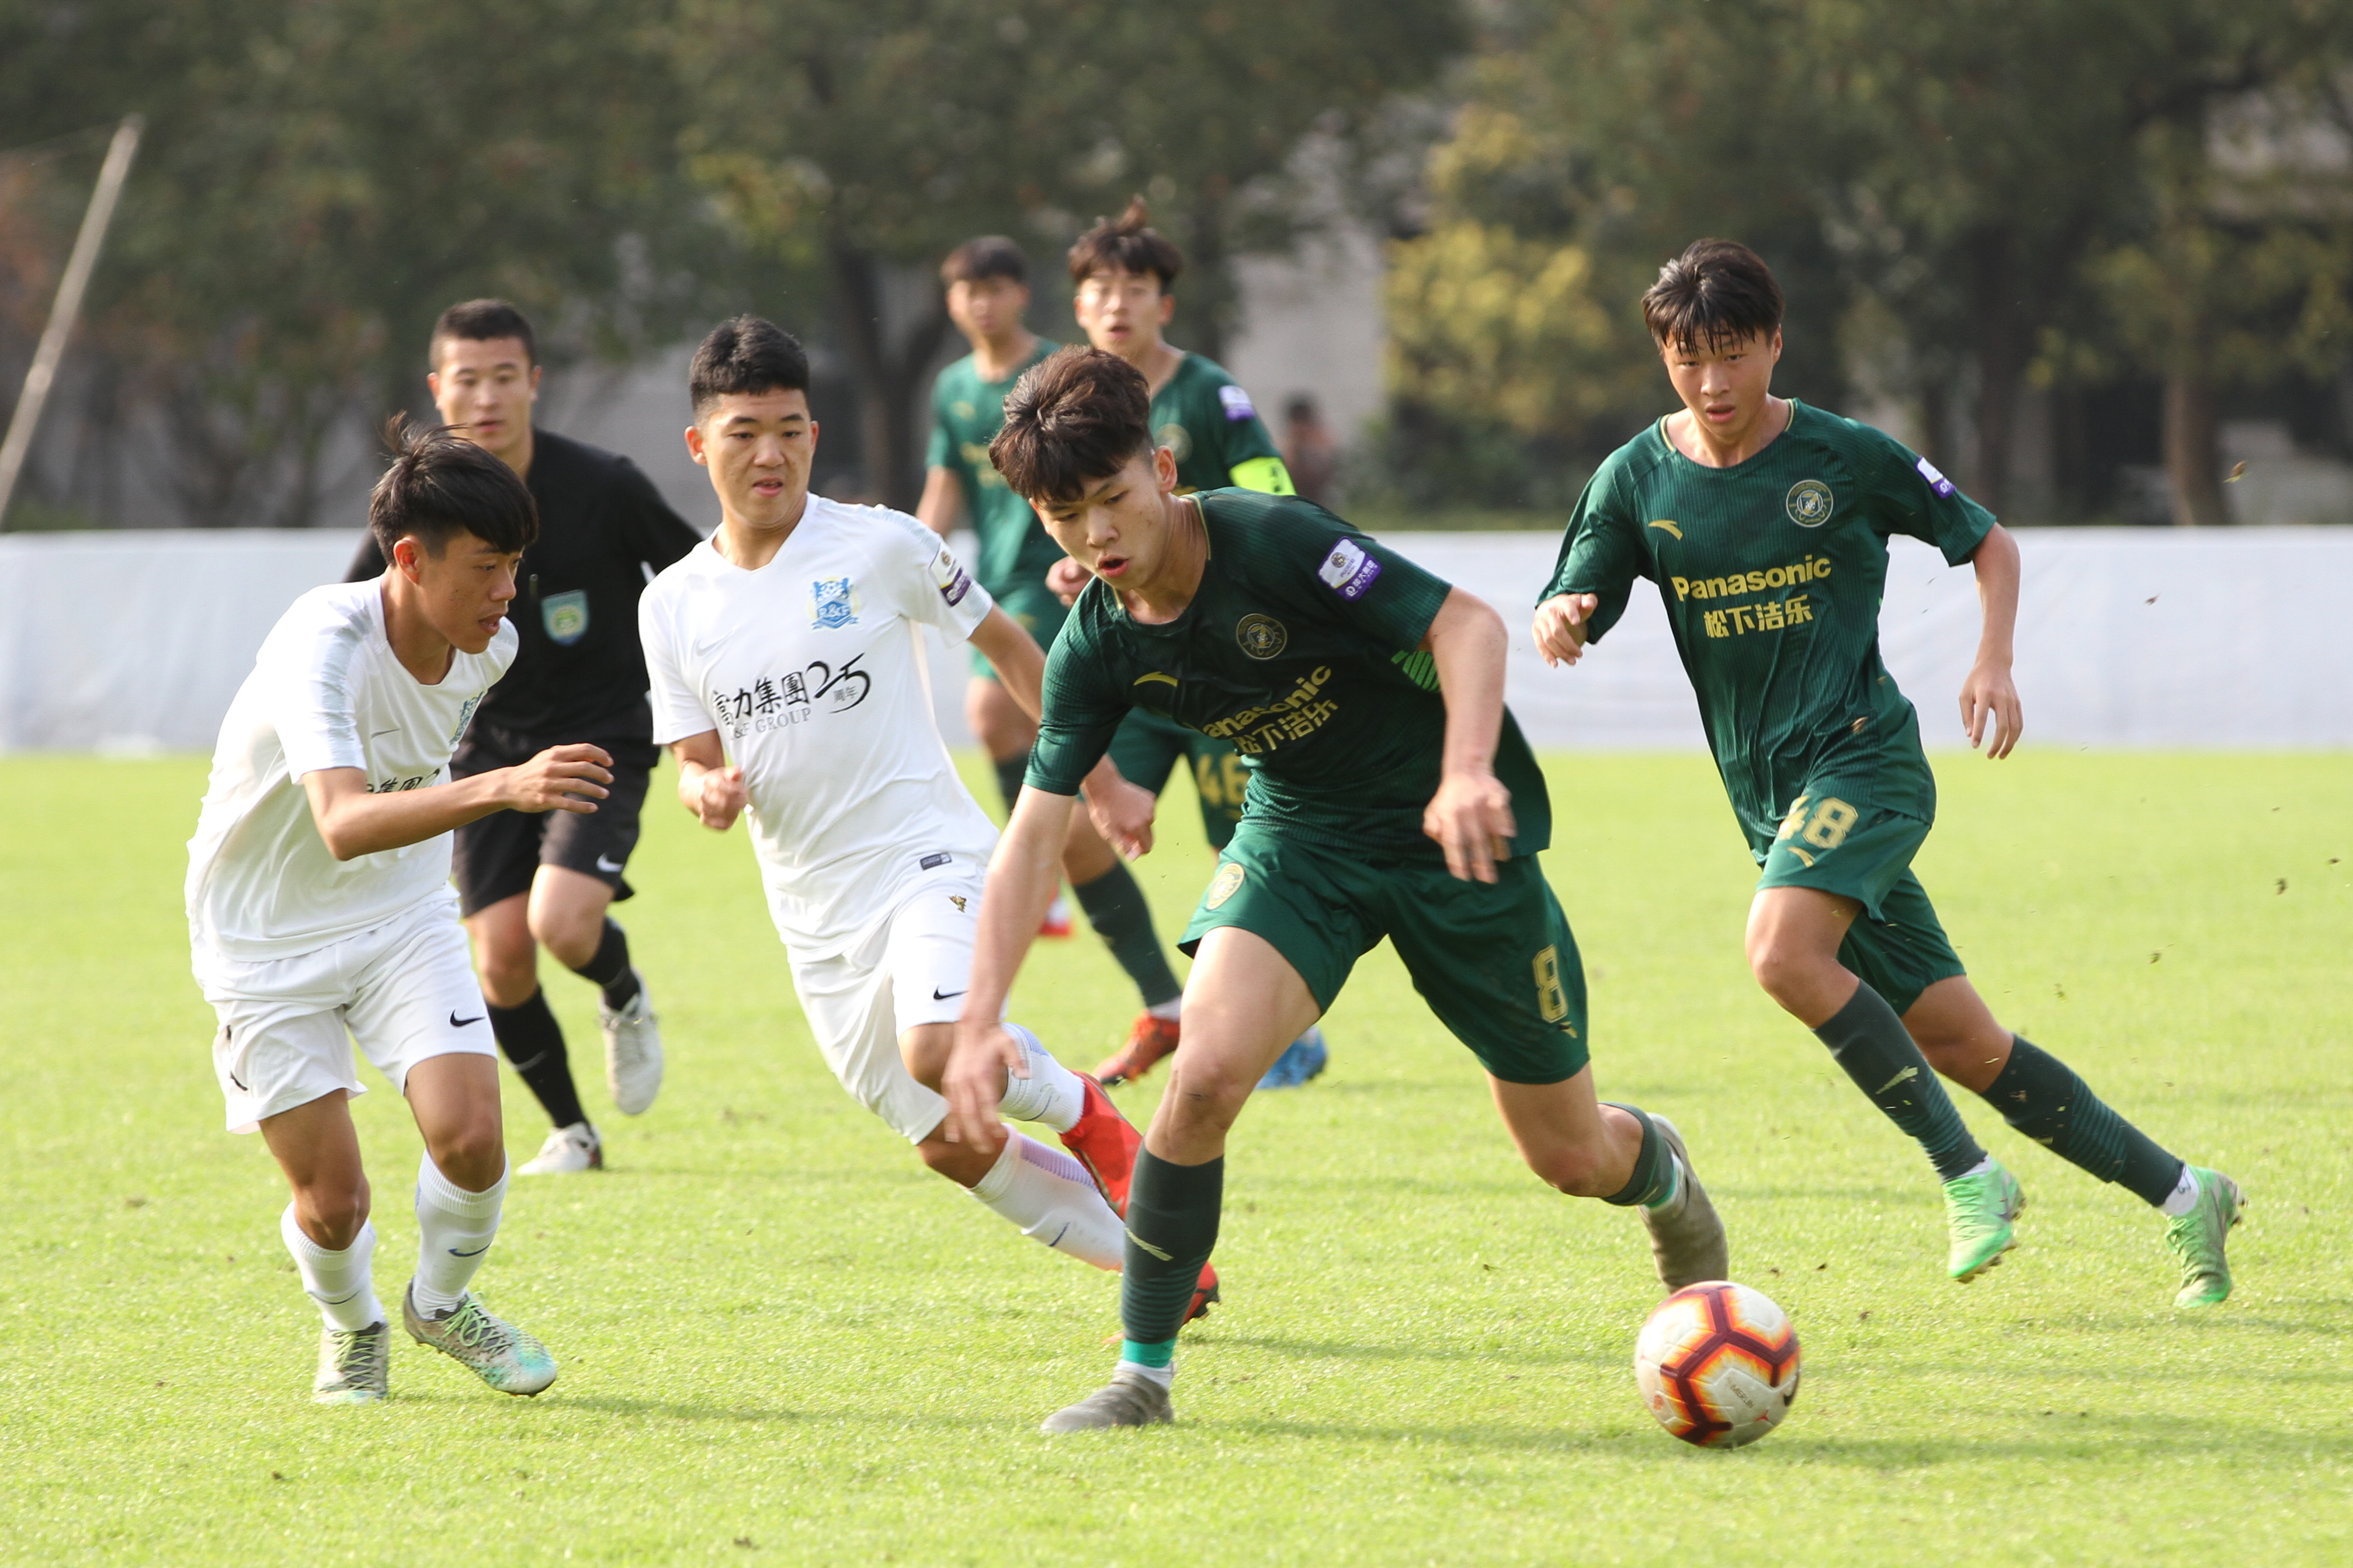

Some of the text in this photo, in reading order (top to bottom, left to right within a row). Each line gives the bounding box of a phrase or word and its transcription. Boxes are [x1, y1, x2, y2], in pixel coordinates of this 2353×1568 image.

[1671, 554, 1832, 602] Panasonic
[1703, 594, 1813, 638] 松下洁乐
[805, 652, 870, 715] 25
[1202, 665, 1331, 737] anasonic
[755, 707, 811, 733] GROUP
[1532, 943, 1568, 1023] 8
